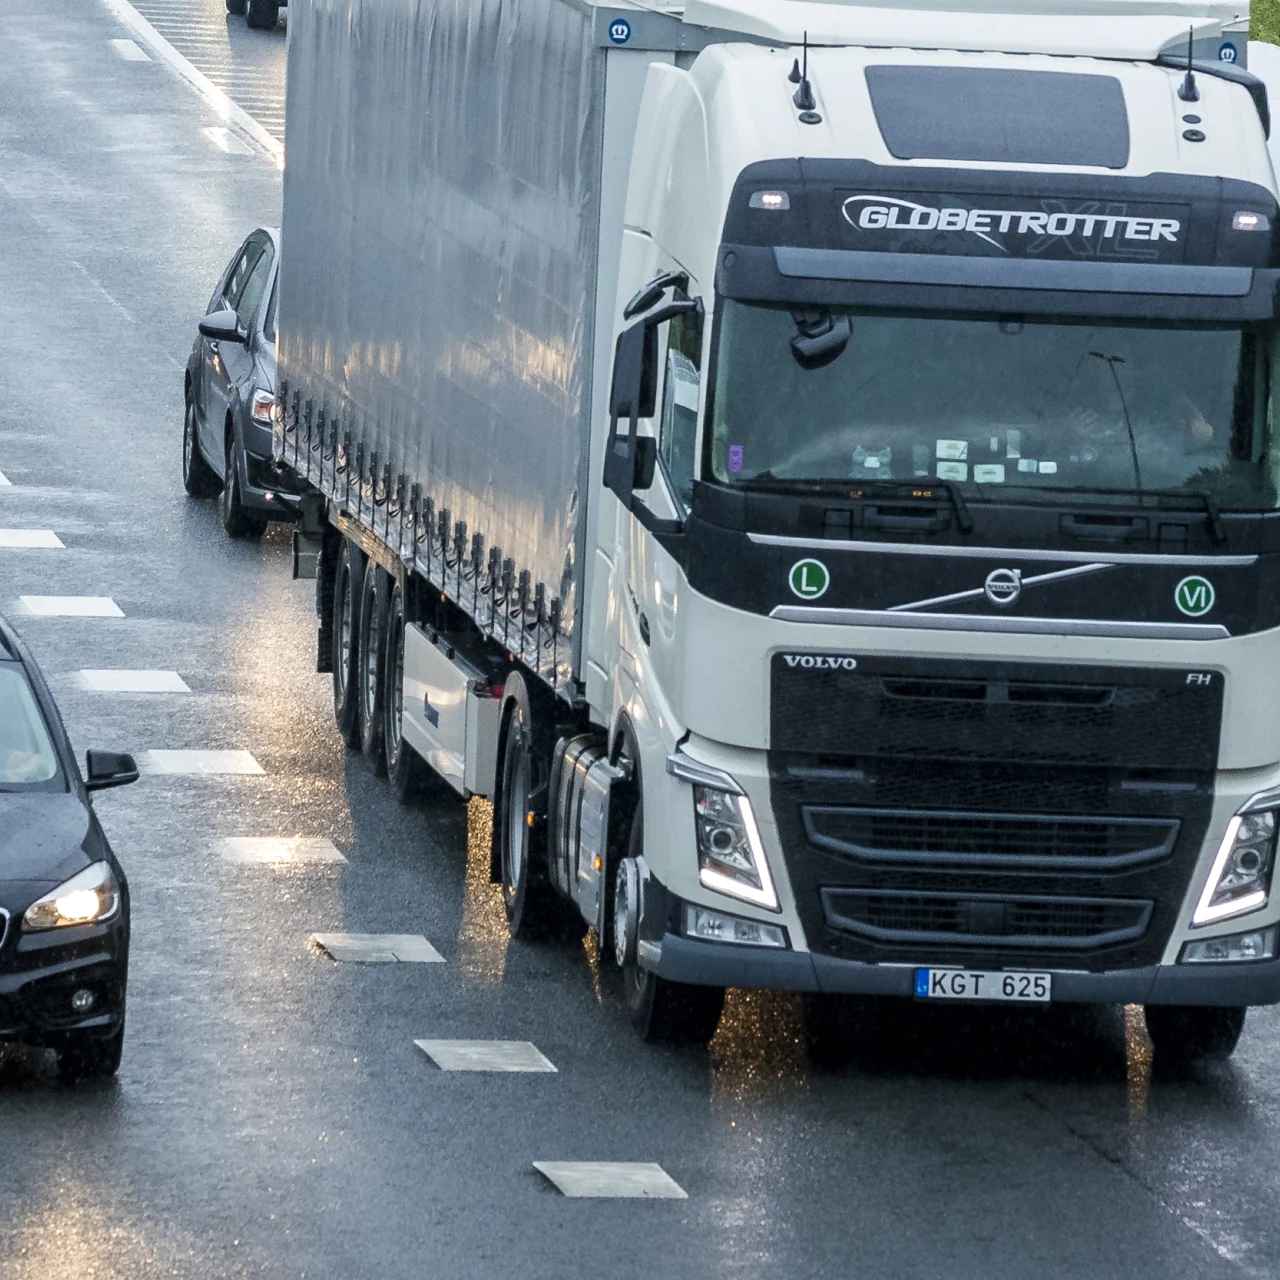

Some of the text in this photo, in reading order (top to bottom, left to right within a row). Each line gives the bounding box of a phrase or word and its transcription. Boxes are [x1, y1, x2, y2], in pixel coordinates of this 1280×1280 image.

[858, 205, 1181, 242] GLOBETROTTER
[802, 567, 818, 591] L
[986, 583, 1020, 592] VOLVO
[1182, 586, 1206, 607] VI
[783, 654, 858, 671] VOLVO
[1185, 671, 1212, 687] FH
[932, 972, 1047, 998] KGT 625
